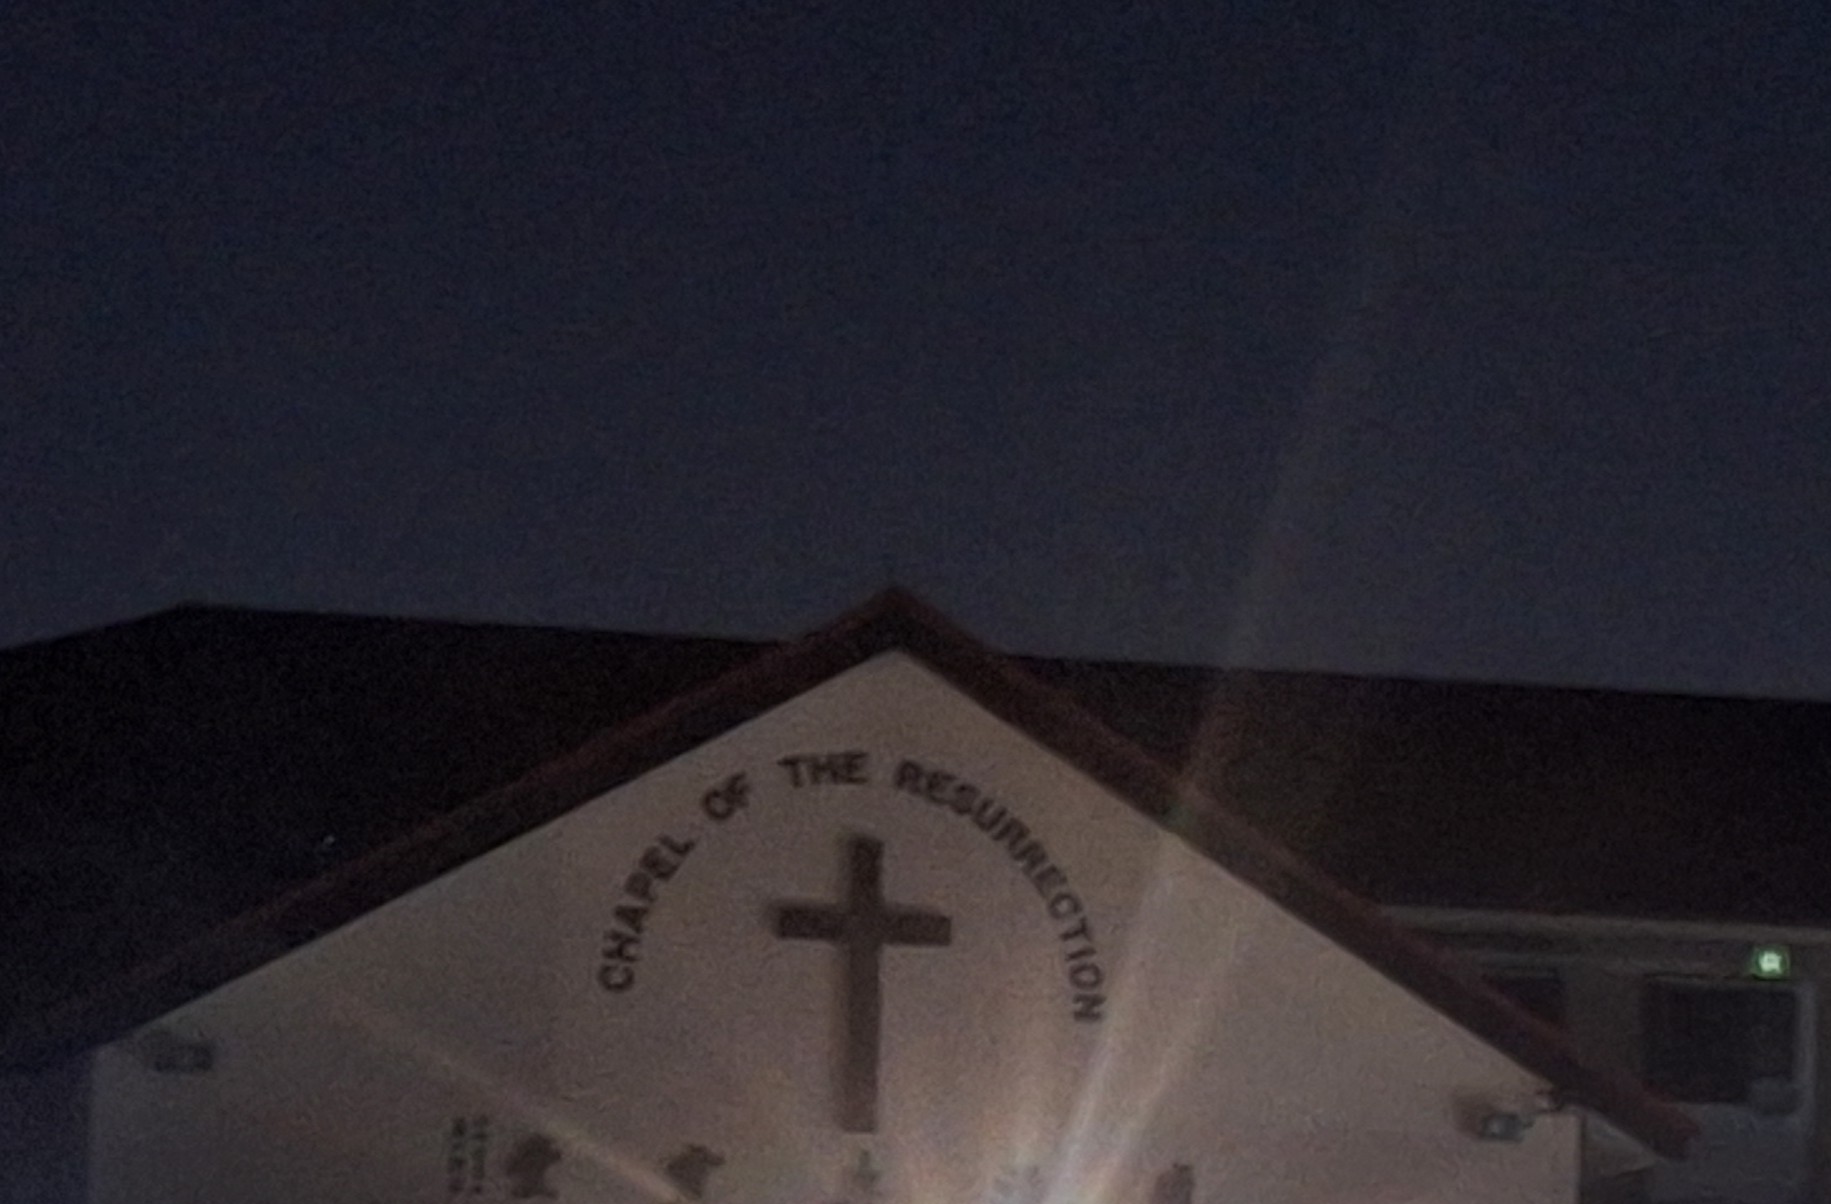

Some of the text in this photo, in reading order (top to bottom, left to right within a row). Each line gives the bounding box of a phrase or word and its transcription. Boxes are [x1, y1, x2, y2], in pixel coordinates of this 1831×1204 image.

[599, 751, 1106, 1023] CHAPEL OF THE RESURRECTION
